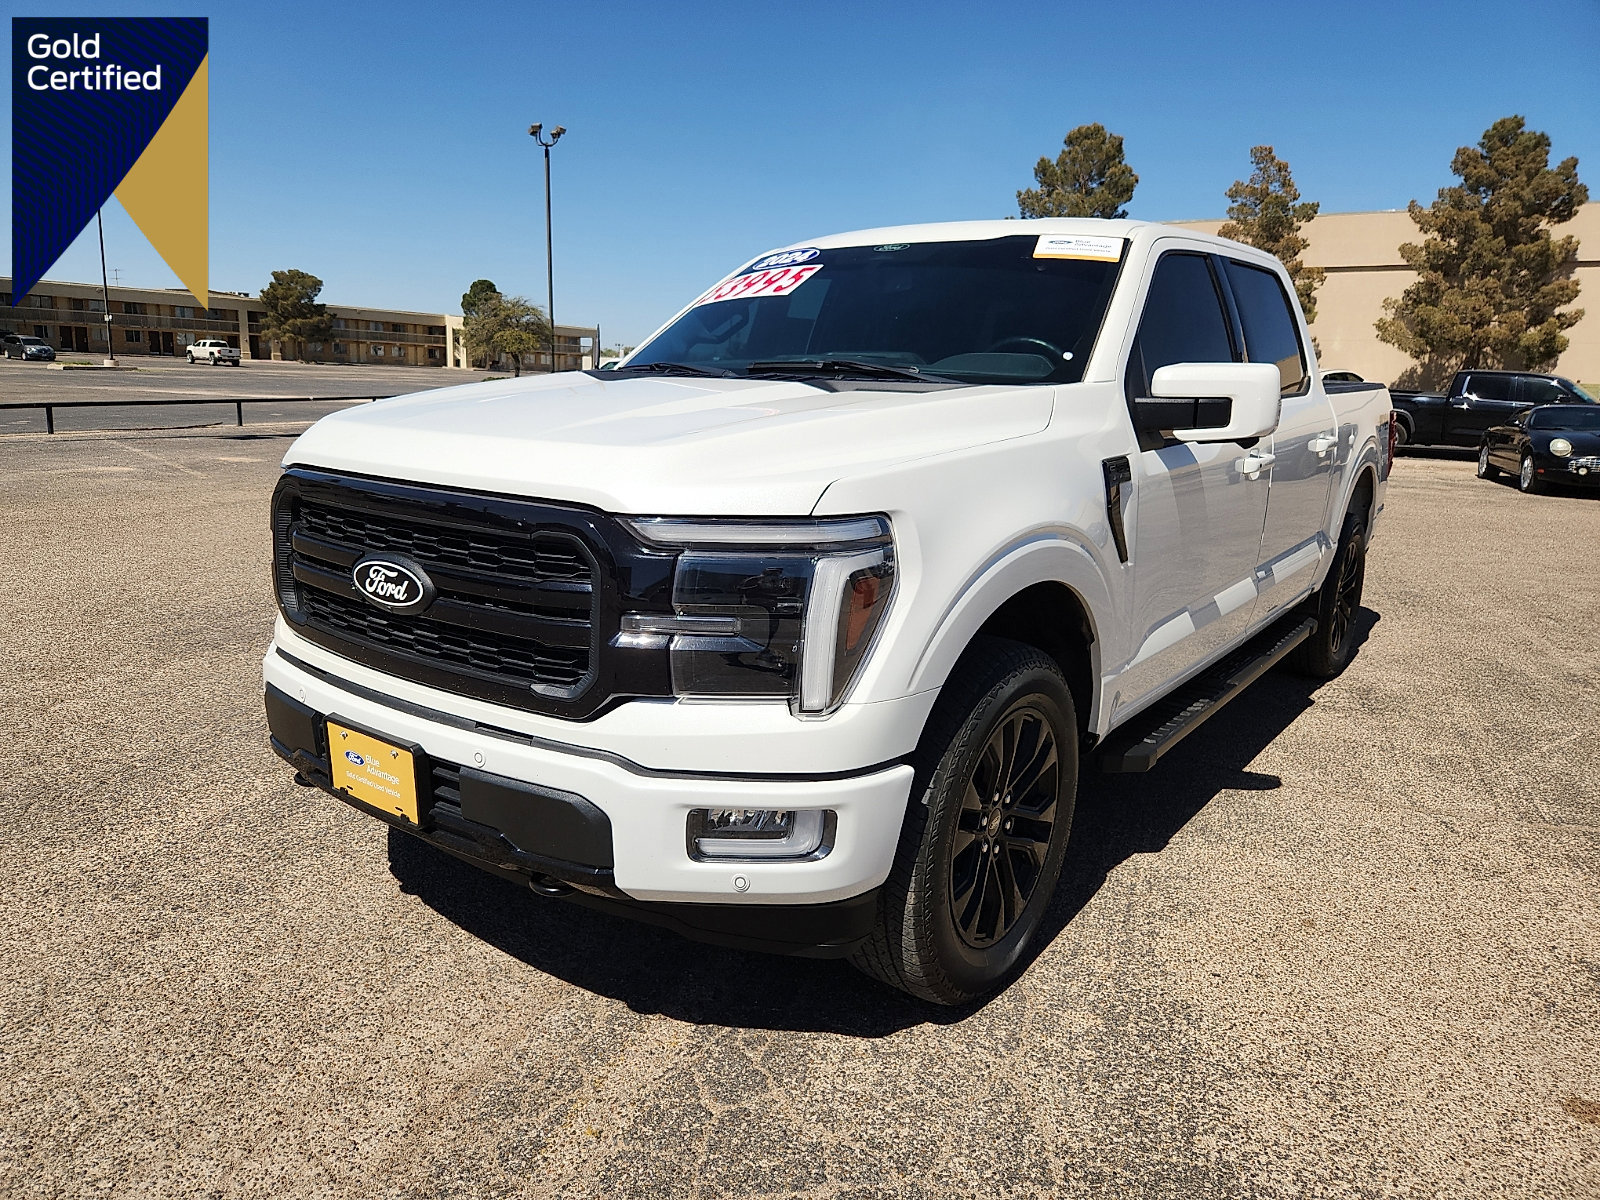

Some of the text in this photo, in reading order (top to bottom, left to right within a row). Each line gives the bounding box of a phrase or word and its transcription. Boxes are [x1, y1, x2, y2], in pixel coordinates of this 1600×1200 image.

[756, 250, 813, 268] 2024
[365, 565, 410, 601] Ford
[366, 755, 380, 767] Blue
[366, 765, 400, 785] Advantage
